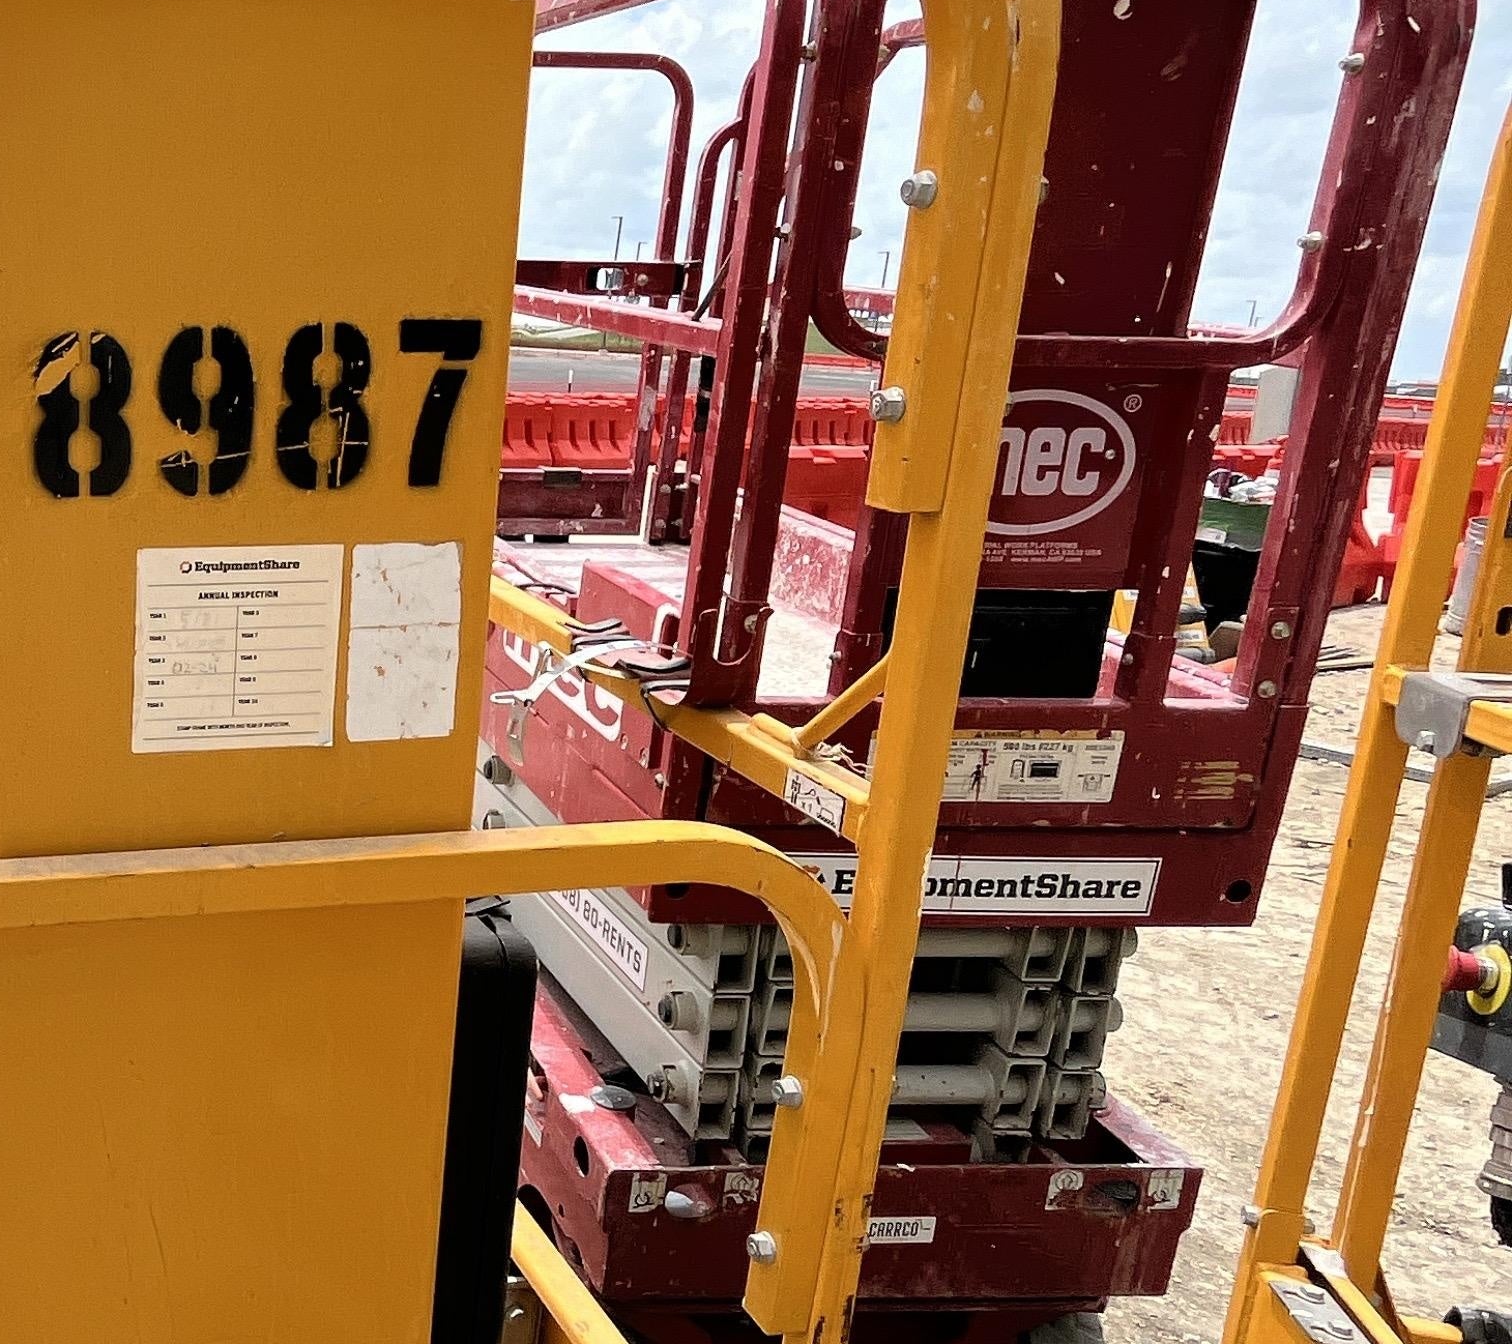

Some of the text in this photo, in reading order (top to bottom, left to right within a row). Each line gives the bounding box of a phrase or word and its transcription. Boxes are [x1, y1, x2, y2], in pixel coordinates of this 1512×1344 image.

[33, 319, 483, 498] 8987
[194, 560, 300, 573] EquipmentShare
[198, 590, 279, 600] ANNUAL INSPECTION
[583, 900, 642, 974] 80-RENTS
